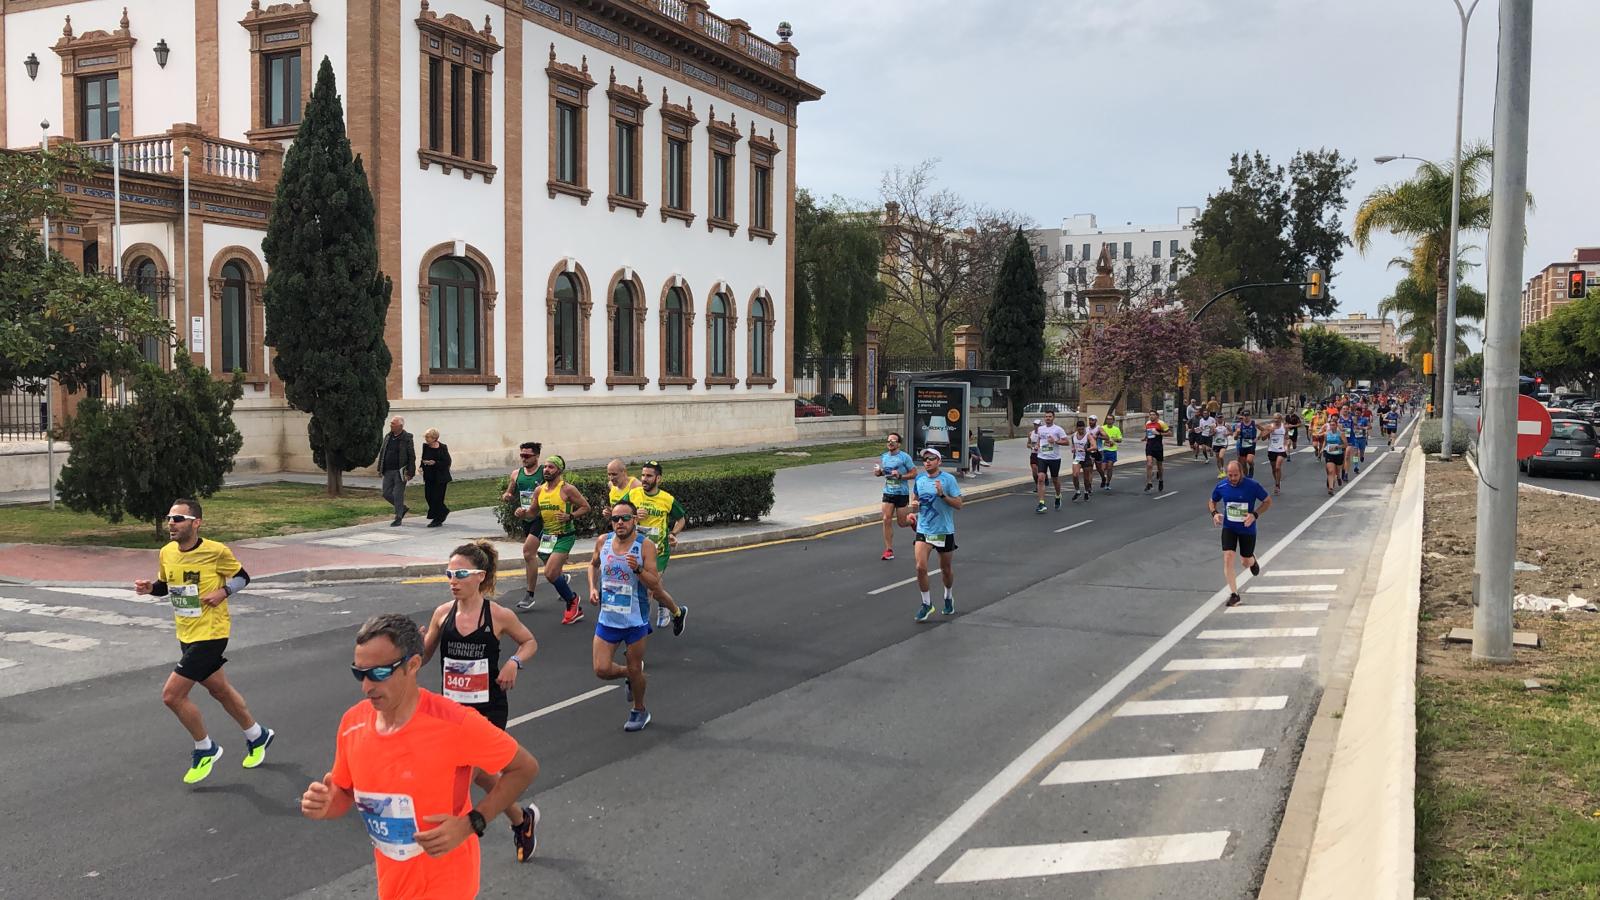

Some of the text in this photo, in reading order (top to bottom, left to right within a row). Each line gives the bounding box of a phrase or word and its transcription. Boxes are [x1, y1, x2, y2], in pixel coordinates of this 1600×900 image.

[448, 641, 486, 650] MIDNIGHT
[448, 648, 484, 658] RUNNERS
[447, 676, 472, 688] 3407
[368, 818, 389, 836] 135
